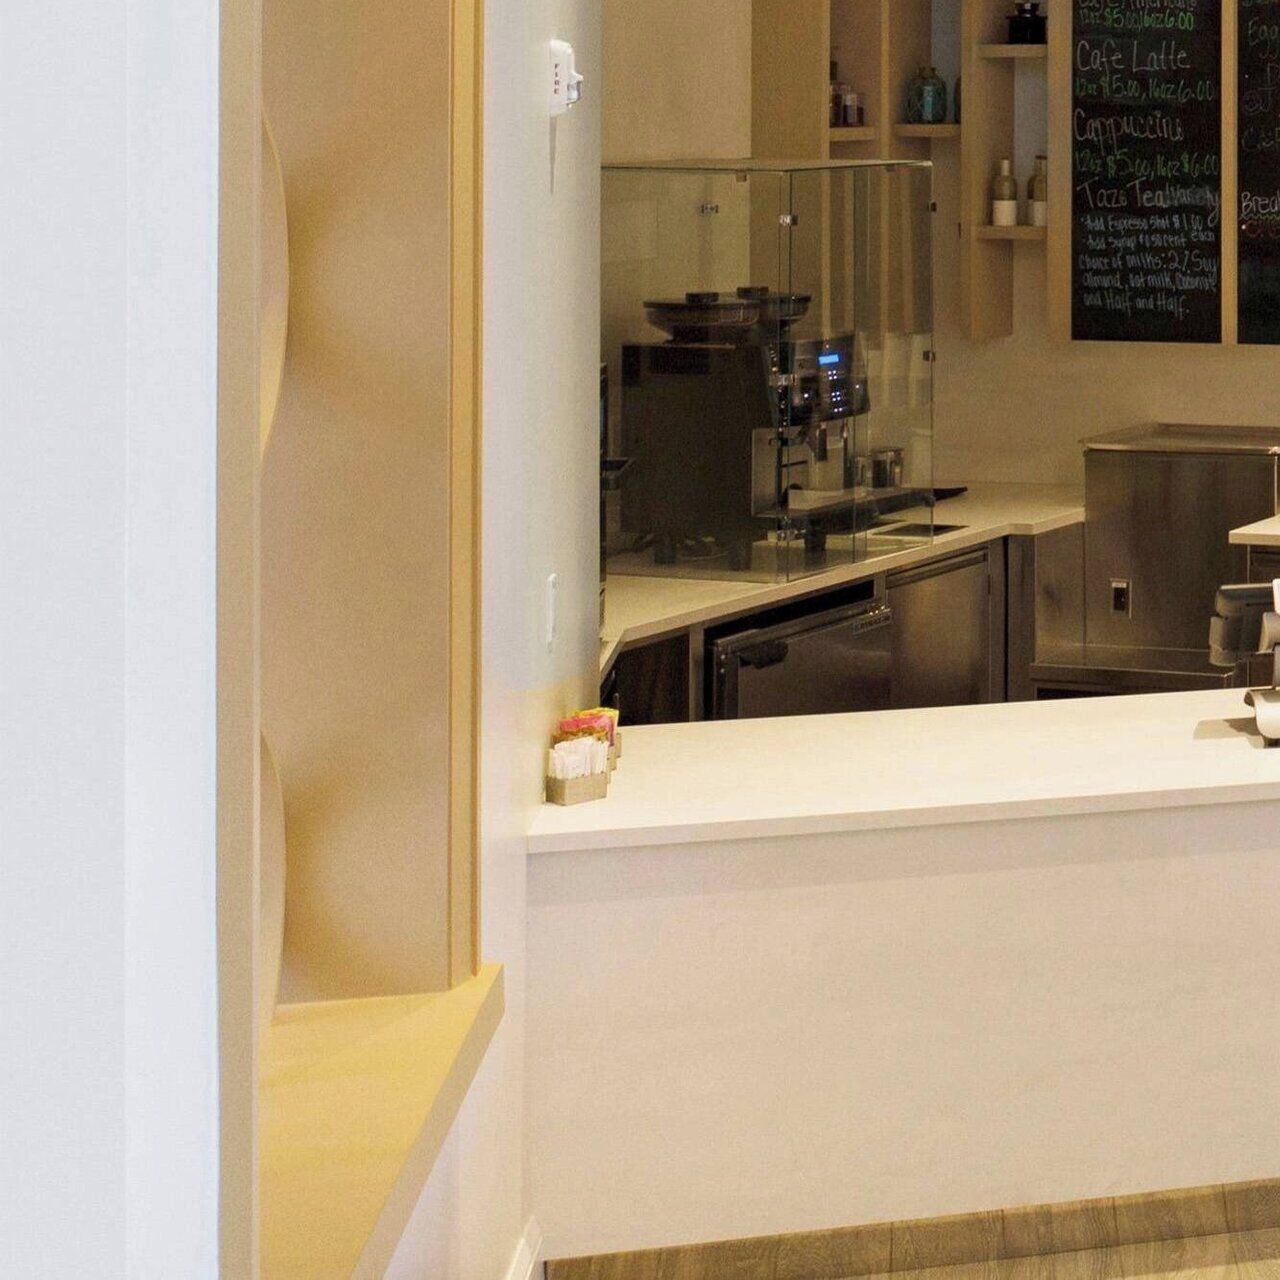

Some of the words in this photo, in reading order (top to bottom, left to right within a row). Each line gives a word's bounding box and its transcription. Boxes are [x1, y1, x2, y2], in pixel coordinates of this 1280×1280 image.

[1077, 38, 1126, 82] Cafe
[1132, 39, 1192, 73] Latte
[1074, 108, 1185, 158] Cappuccino
[1077, 176, 1129, 209] Tazo
[1135, 292, 1155, 310] and
